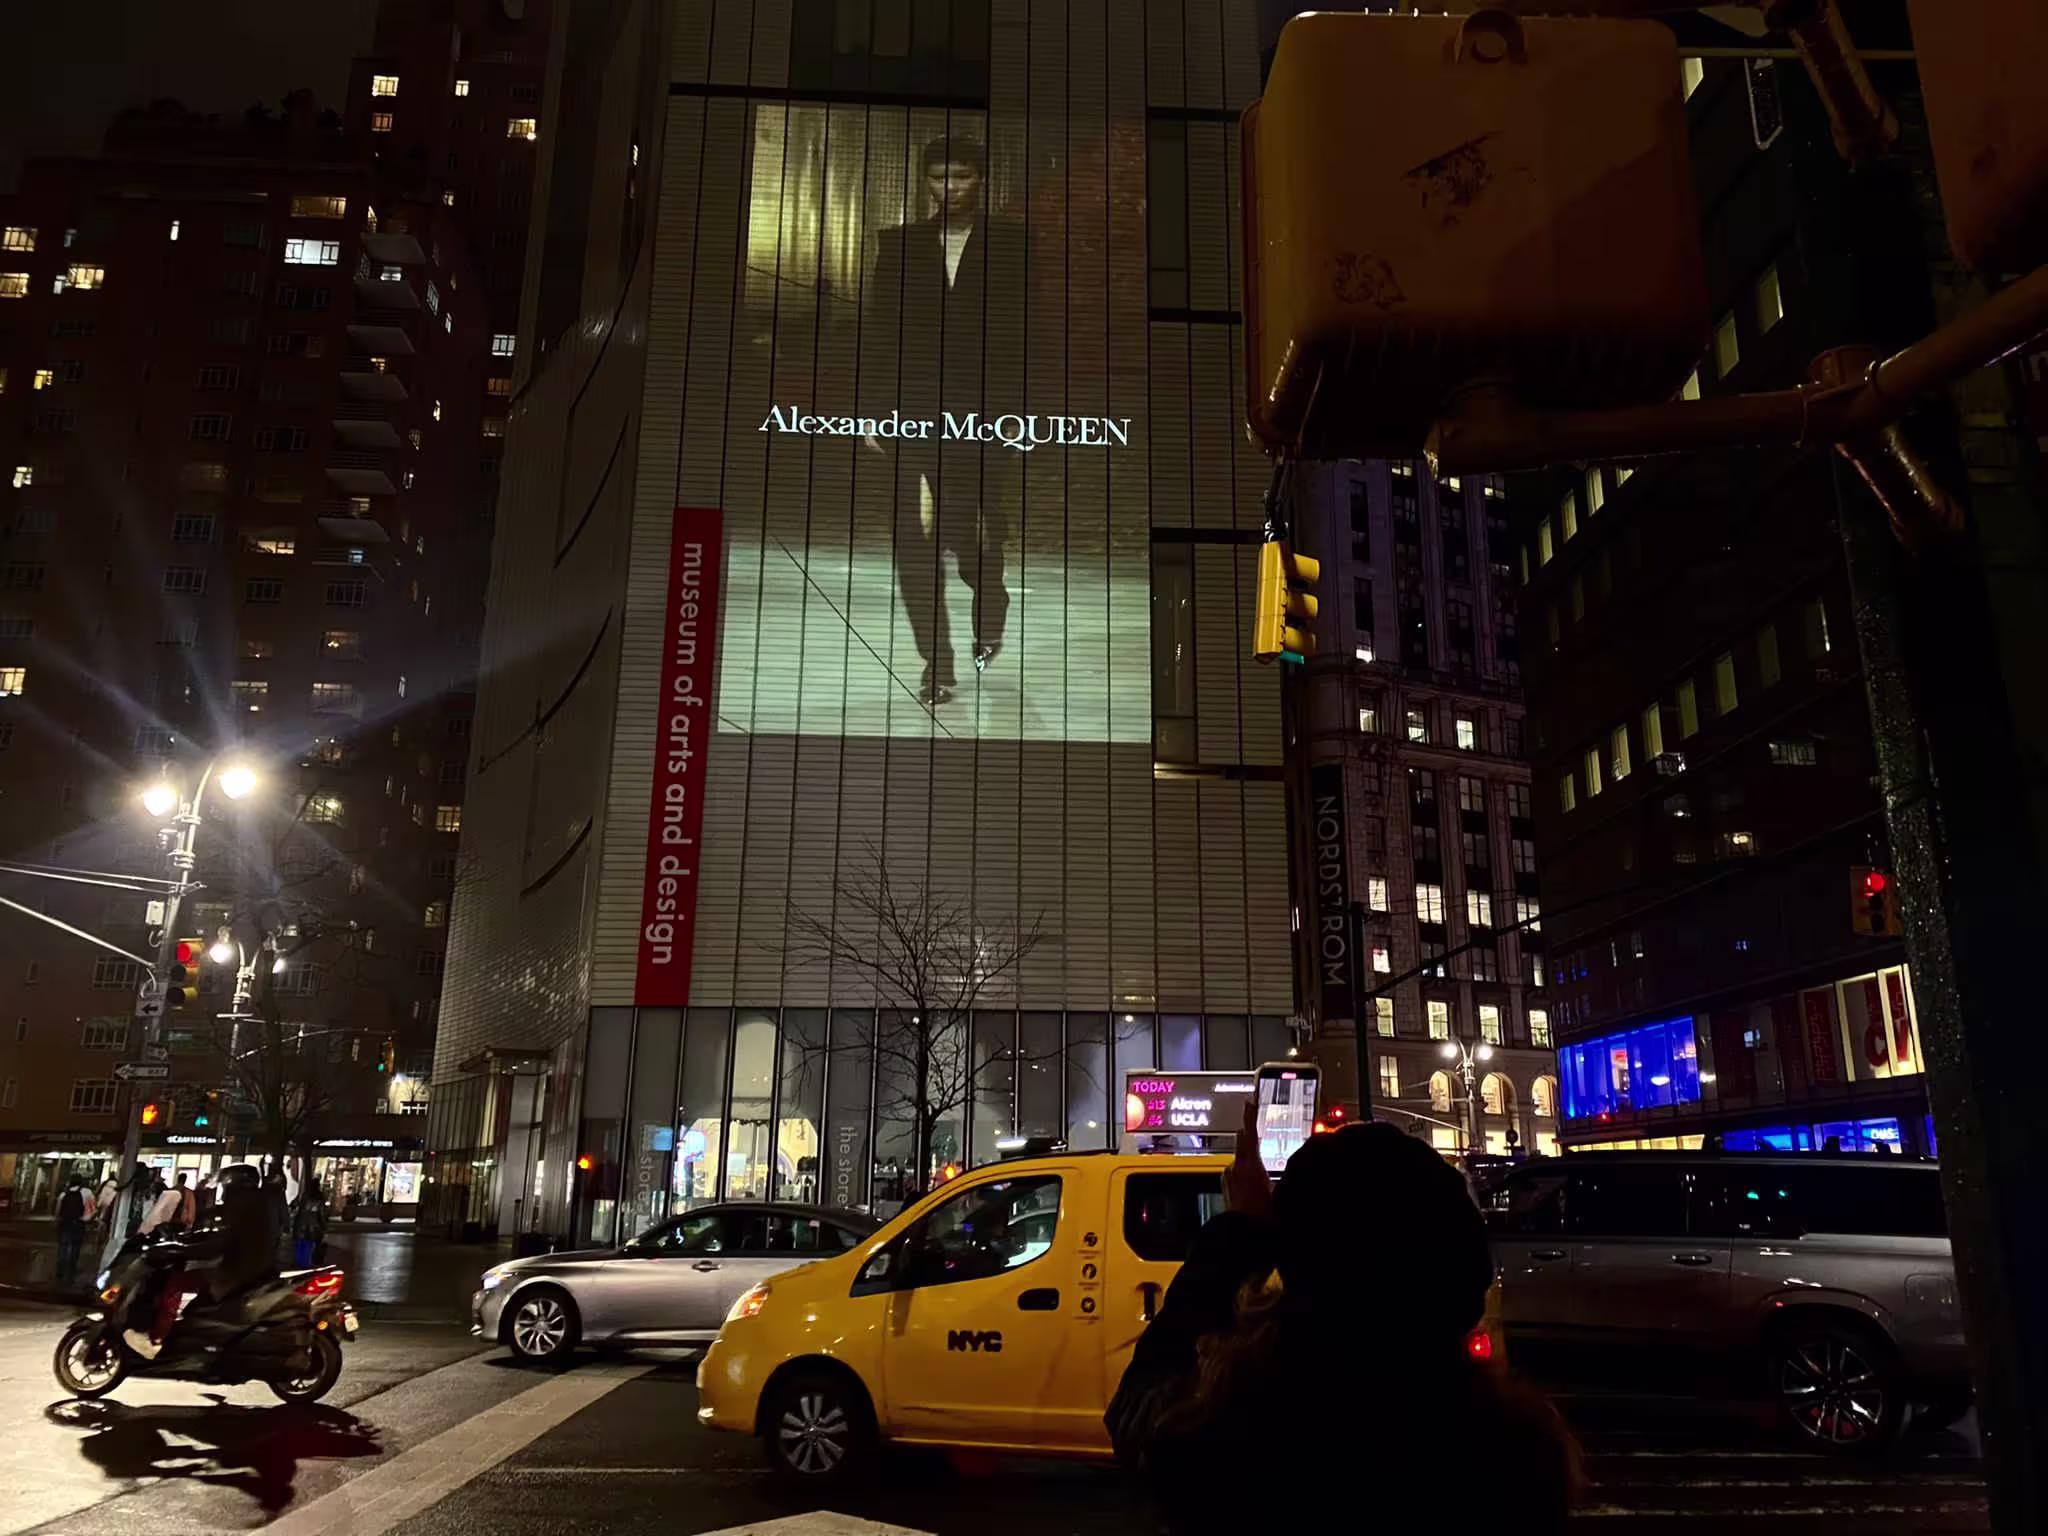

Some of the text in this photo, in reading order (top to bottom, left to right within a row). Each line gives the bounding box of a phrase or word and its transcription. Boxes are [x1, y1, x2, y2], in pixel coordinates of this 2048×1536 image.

[759, 405, 1132, 452] Alexander McQUEEN
[645, 542, 704, 966] museum of arts and design
[1315, 795, 1347, 986] NORDSTROM
[1133, 1081, 1175, 1093] TODAY
[1170, 1096, 1212, 1111] Akron
[1170, 1112, 1209, 1127] UCLA
[836, 1125, 858, 1205] the store
[947, 1329, 1002, 1353] NYC
